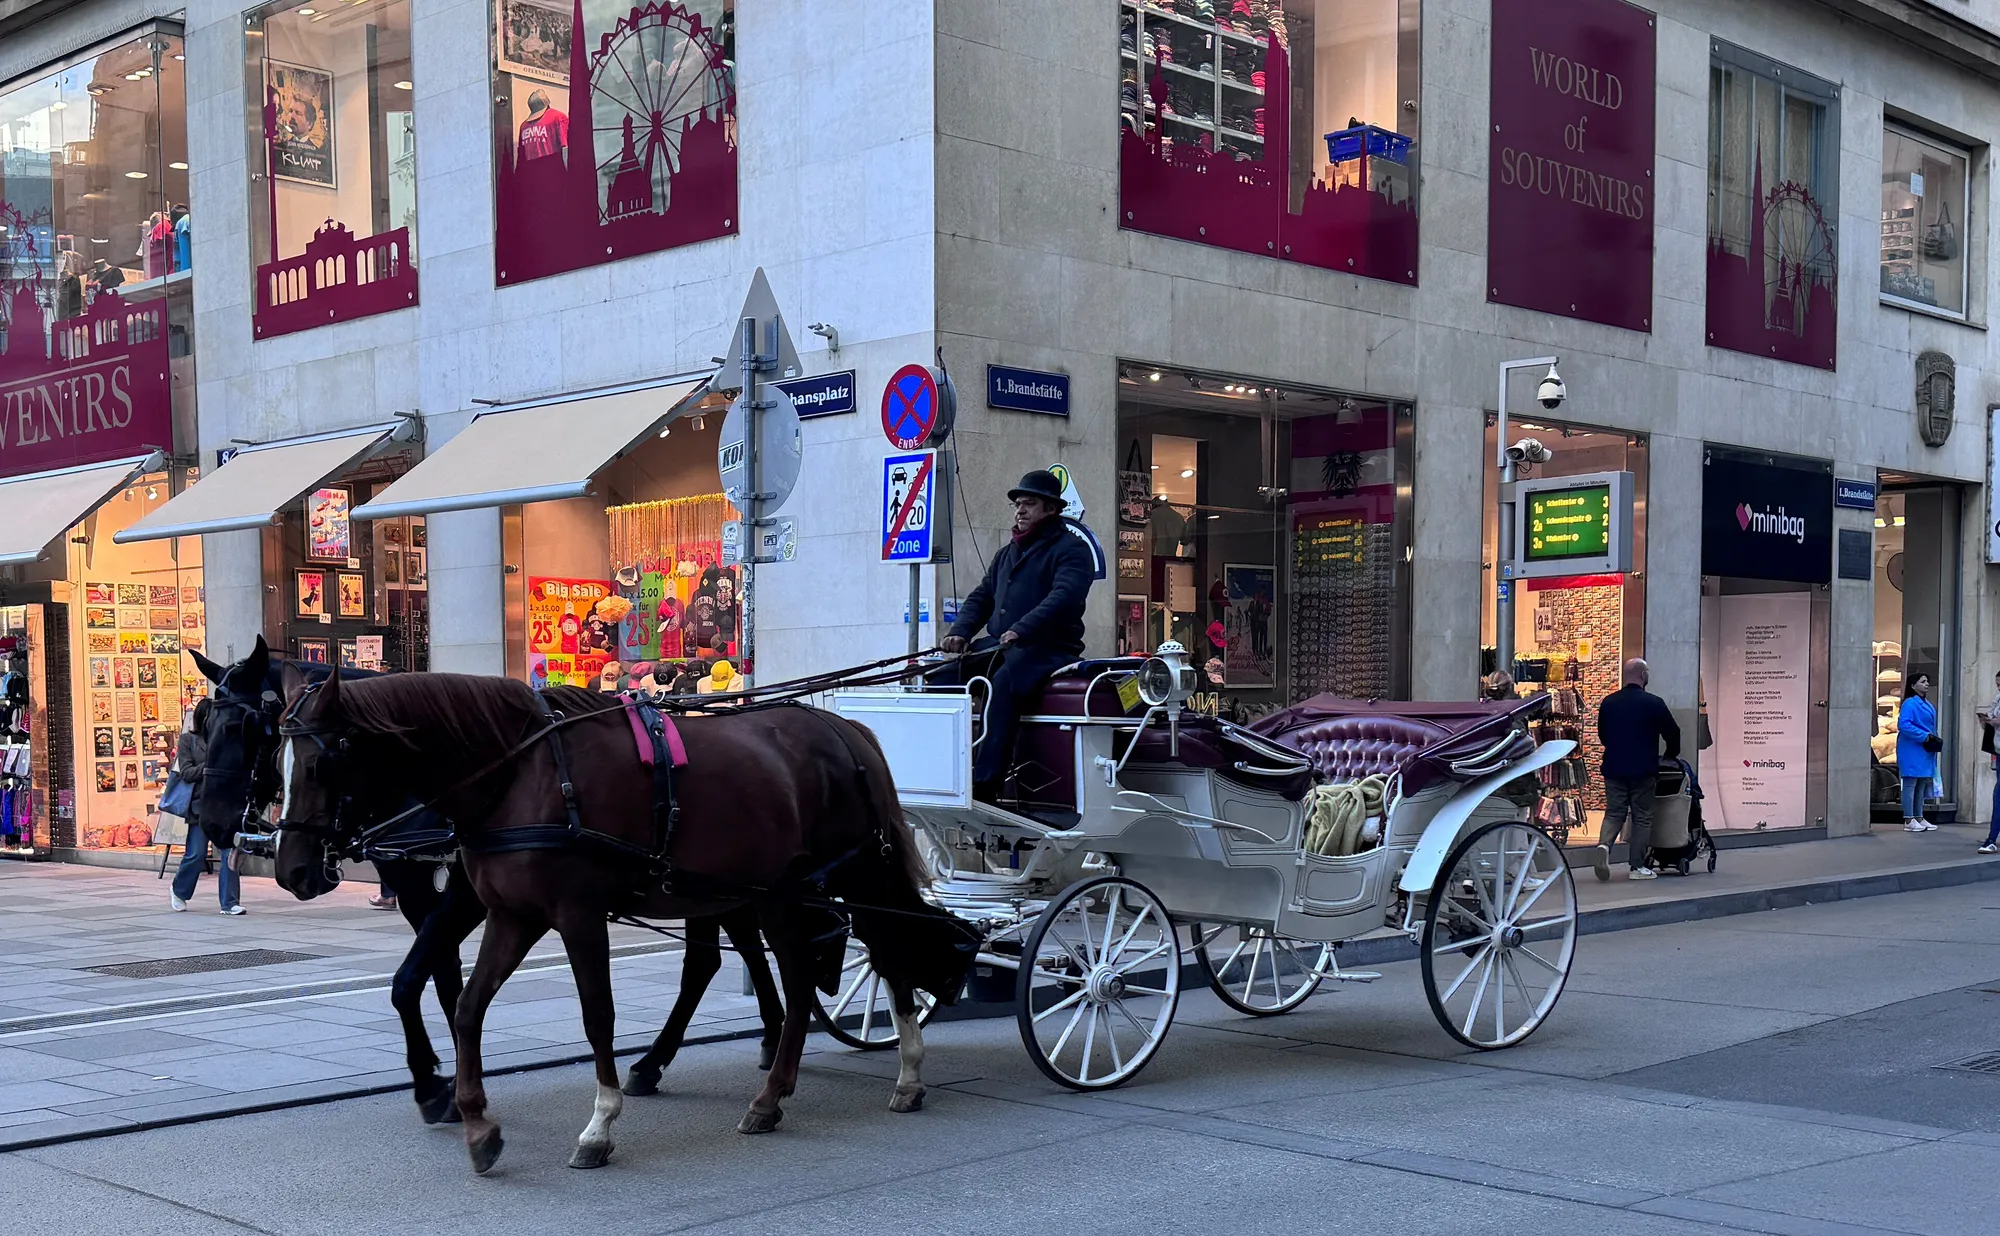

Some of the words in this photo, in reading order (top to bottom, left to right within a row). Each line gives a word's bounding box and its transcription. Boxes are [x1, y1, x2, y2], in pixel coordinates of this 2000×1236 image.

[1529, 46, 1623, 110] WORLD
[1564, 115, 1588, 154] of
[281, 151, 322, 171] KLIMT
[1501, 146, 1644, 220] SOUVENIRS
[897, 436, 919, 450] ENDE
[1602, 496, 1609, 508] 3
[910, 506, 924, 526] 20
[1602, 513, 1609, 527] 2
[1752, 504, 1805, 544] minibag
[891, 537, 921, 554] Zone
[1602, 531, 1609, 544] 3
[546, 581, 570, 598] Big
[572, 583, 602, 598] Sale
[639, 602, 650, 611] für
[532, 620, 553, 644] 25
[626, 612, 650, 648] 25
[548, 659, 571, 675] Big
[575, 660, 603, 673] Sale
[1753, 759, 1786, 770] minibag
